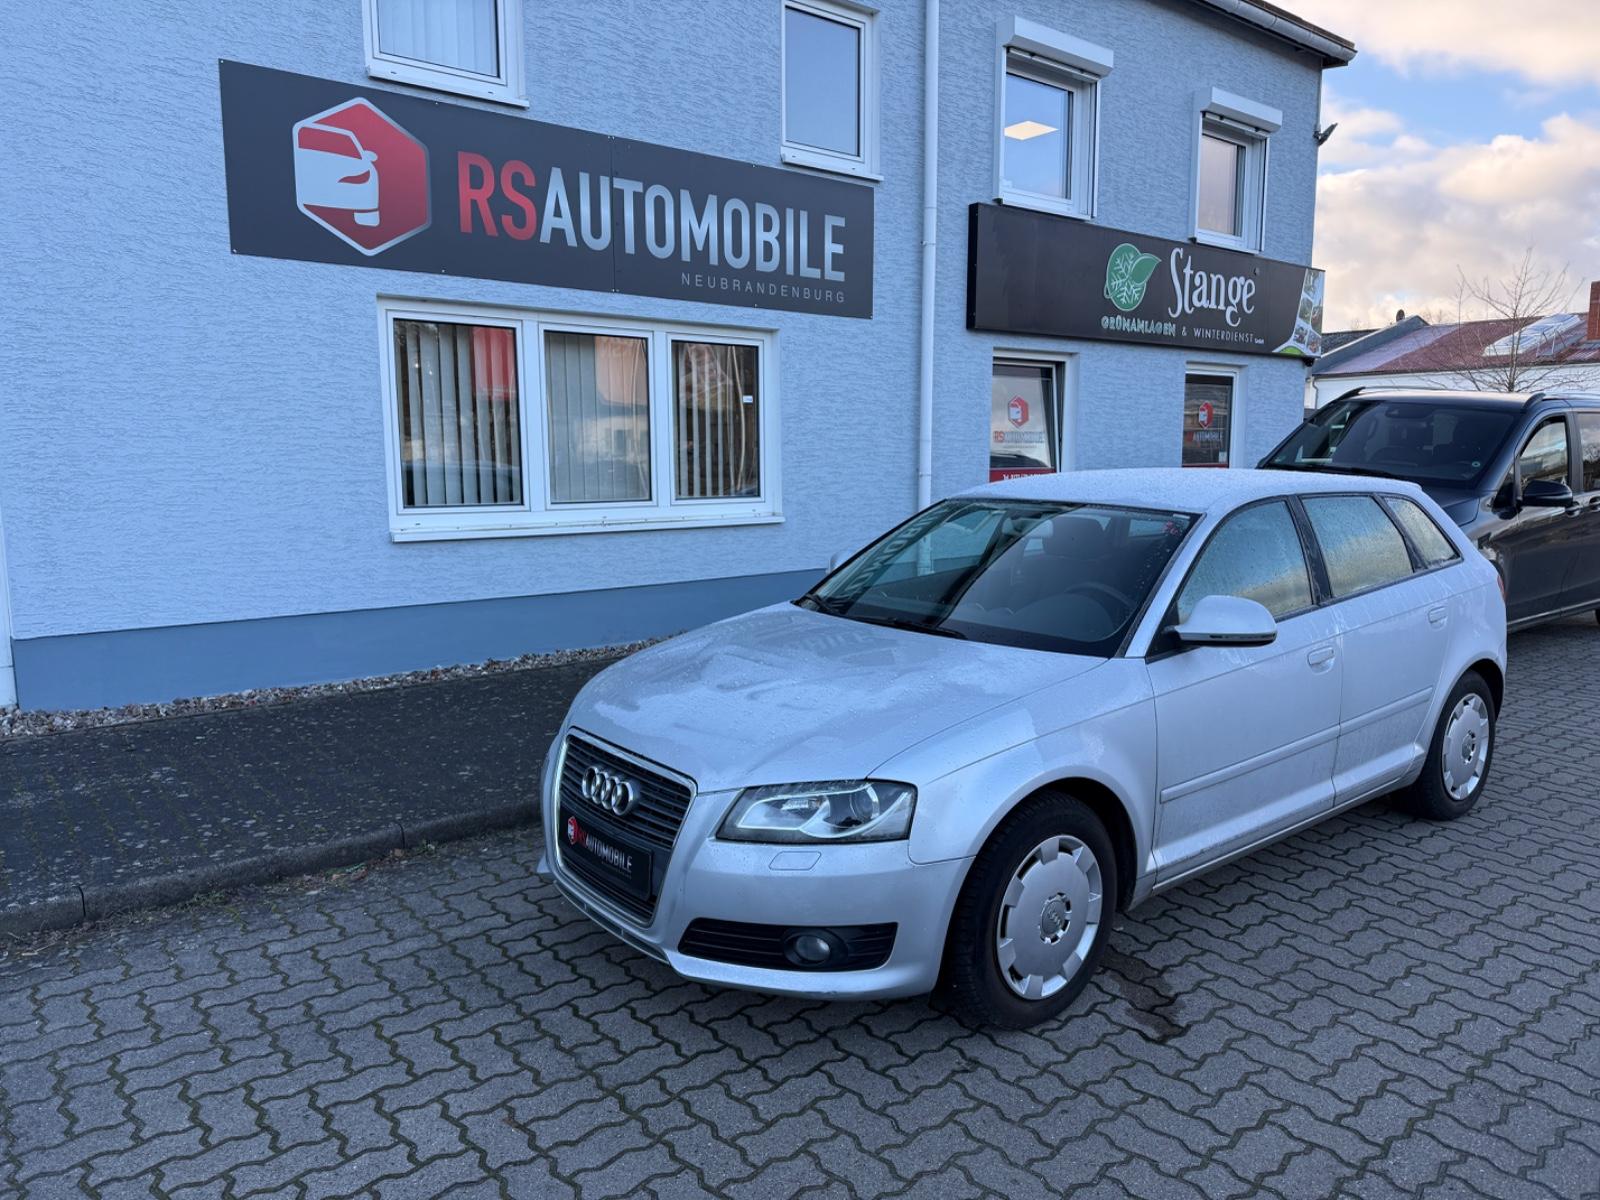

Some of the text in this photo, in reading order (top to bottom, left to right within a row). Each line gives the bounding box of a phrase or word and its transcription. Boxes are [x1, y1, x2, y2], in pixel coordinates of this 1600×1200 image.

[681, 272, 845, 303] NEUBRANDENBURG
[1168, 248, 1256, 327] Stange
[1101, 315, 1176, 337] GRÜNANLAGEN
[1181, 326, 1187, 337] &
[1193, 327, 1254, 344] WINTERDIENST
